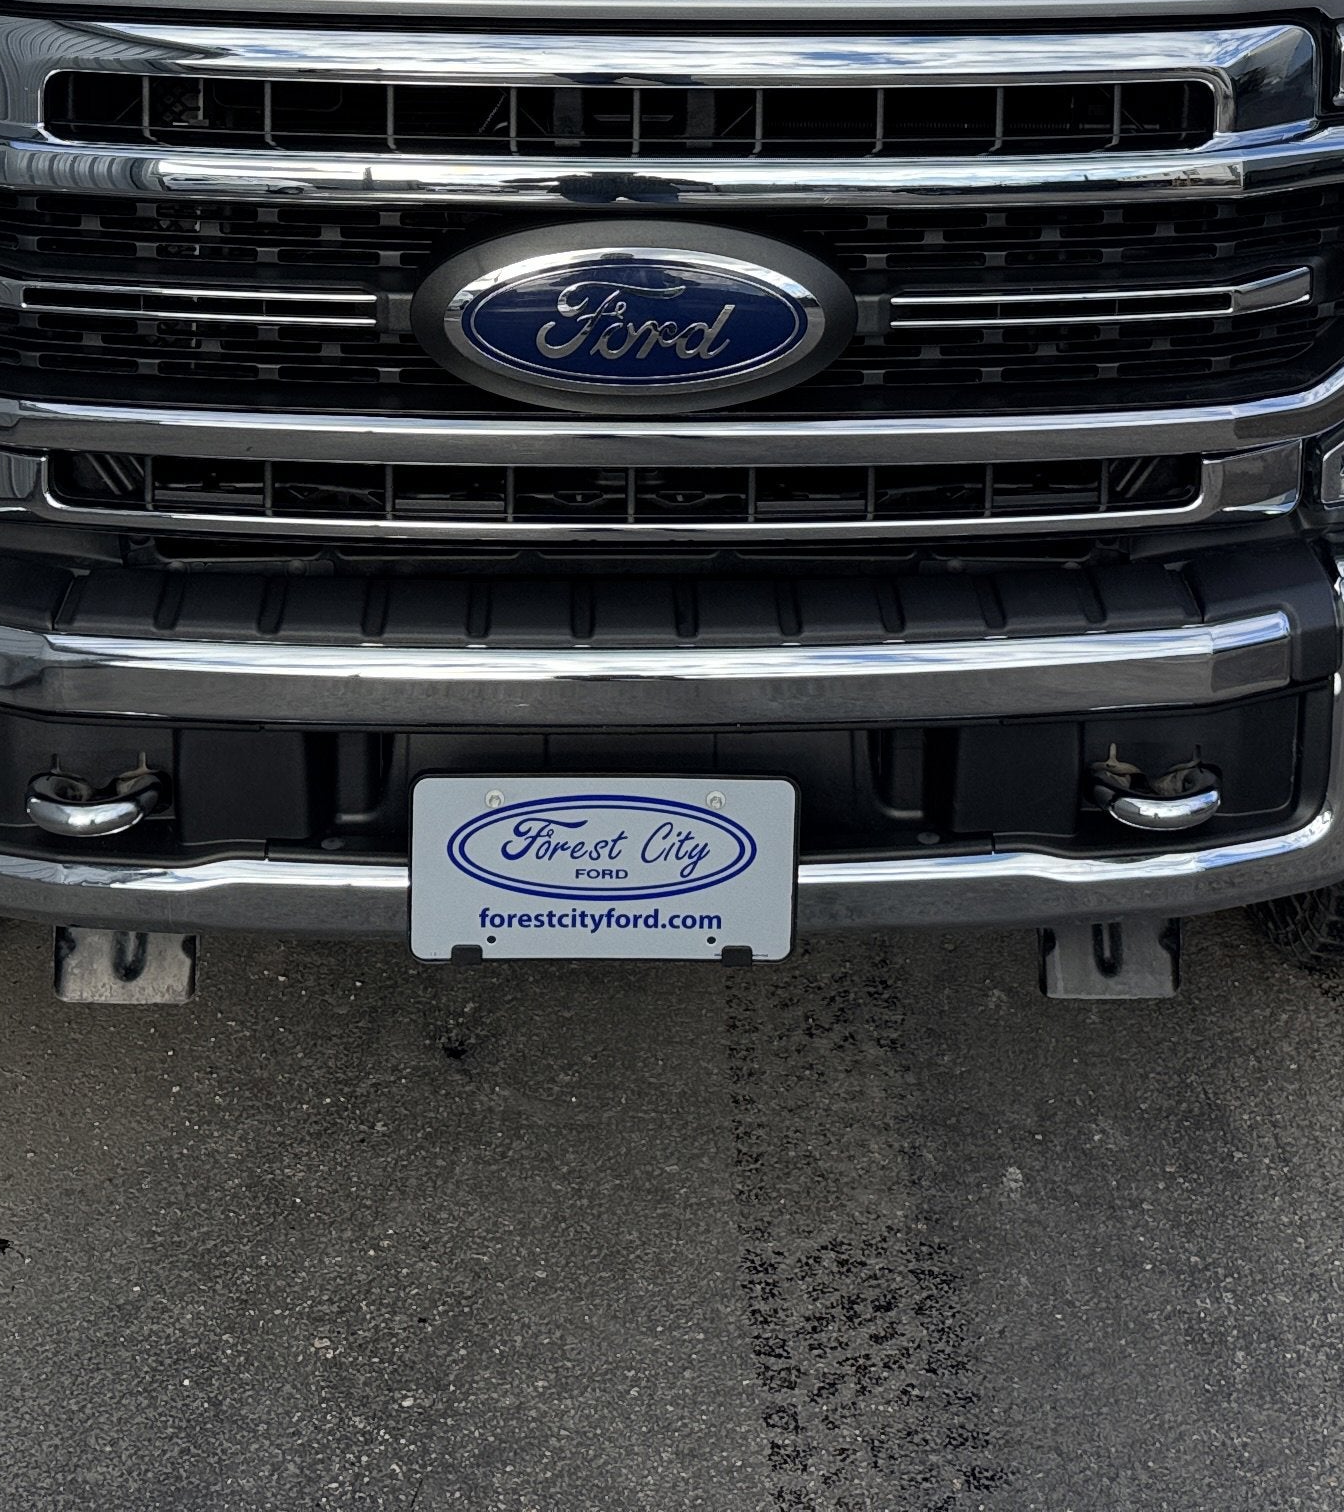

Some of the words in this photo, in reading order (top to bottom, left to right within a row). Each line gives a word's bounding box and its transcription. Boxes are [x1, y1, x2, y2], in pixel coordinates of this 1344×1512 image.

[537, 281, 736, 360] Ford
[501, 817, 627, 862] Forest
[640, 821, 711, 879] City
[574, 867, 629, 881] FORD
[478, 906, 723, 934] forestcityford.com
